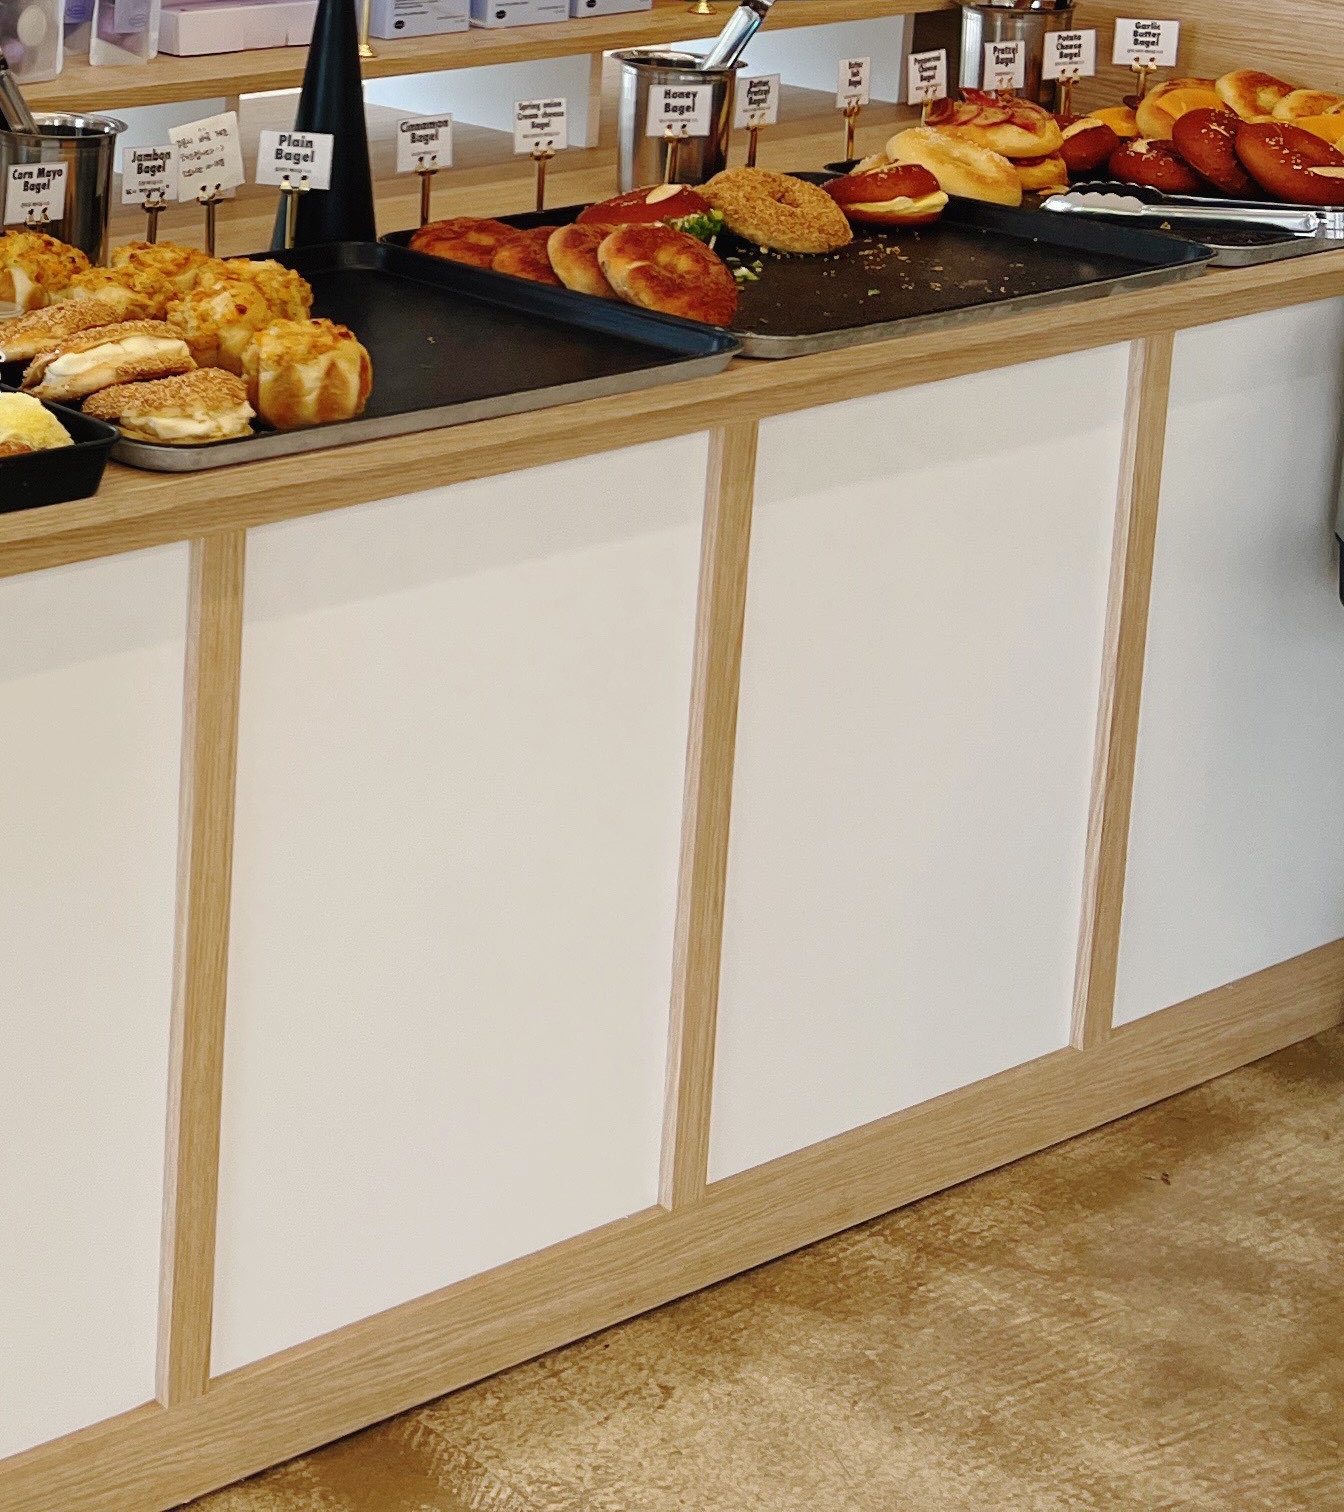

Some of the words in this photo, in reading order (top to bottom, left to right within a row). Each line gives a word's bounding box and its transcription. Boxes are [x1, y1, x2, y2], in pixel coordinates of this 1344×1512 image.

[1132, 37, 1160, 48] Bagel
[1058, 49, 1081, 60] Bagel
[663, 89, 699, 100] Honey
[663, 99, 696, 116] Bagel
[400, 119, 449, 133] Cinnamon
[278, 134, 314, 148] Plain
[410, 130, 440, 145] Bagel
[131, 149, 172, 163] Jambon
[274, 148, 315, 165] Bagel
[12, 169, 34, 180] Corn
[36, 167, 64, 180] Mayo
[136, 161, 166, 177] Bagel
[22, 179, 51, 194] Bagel
